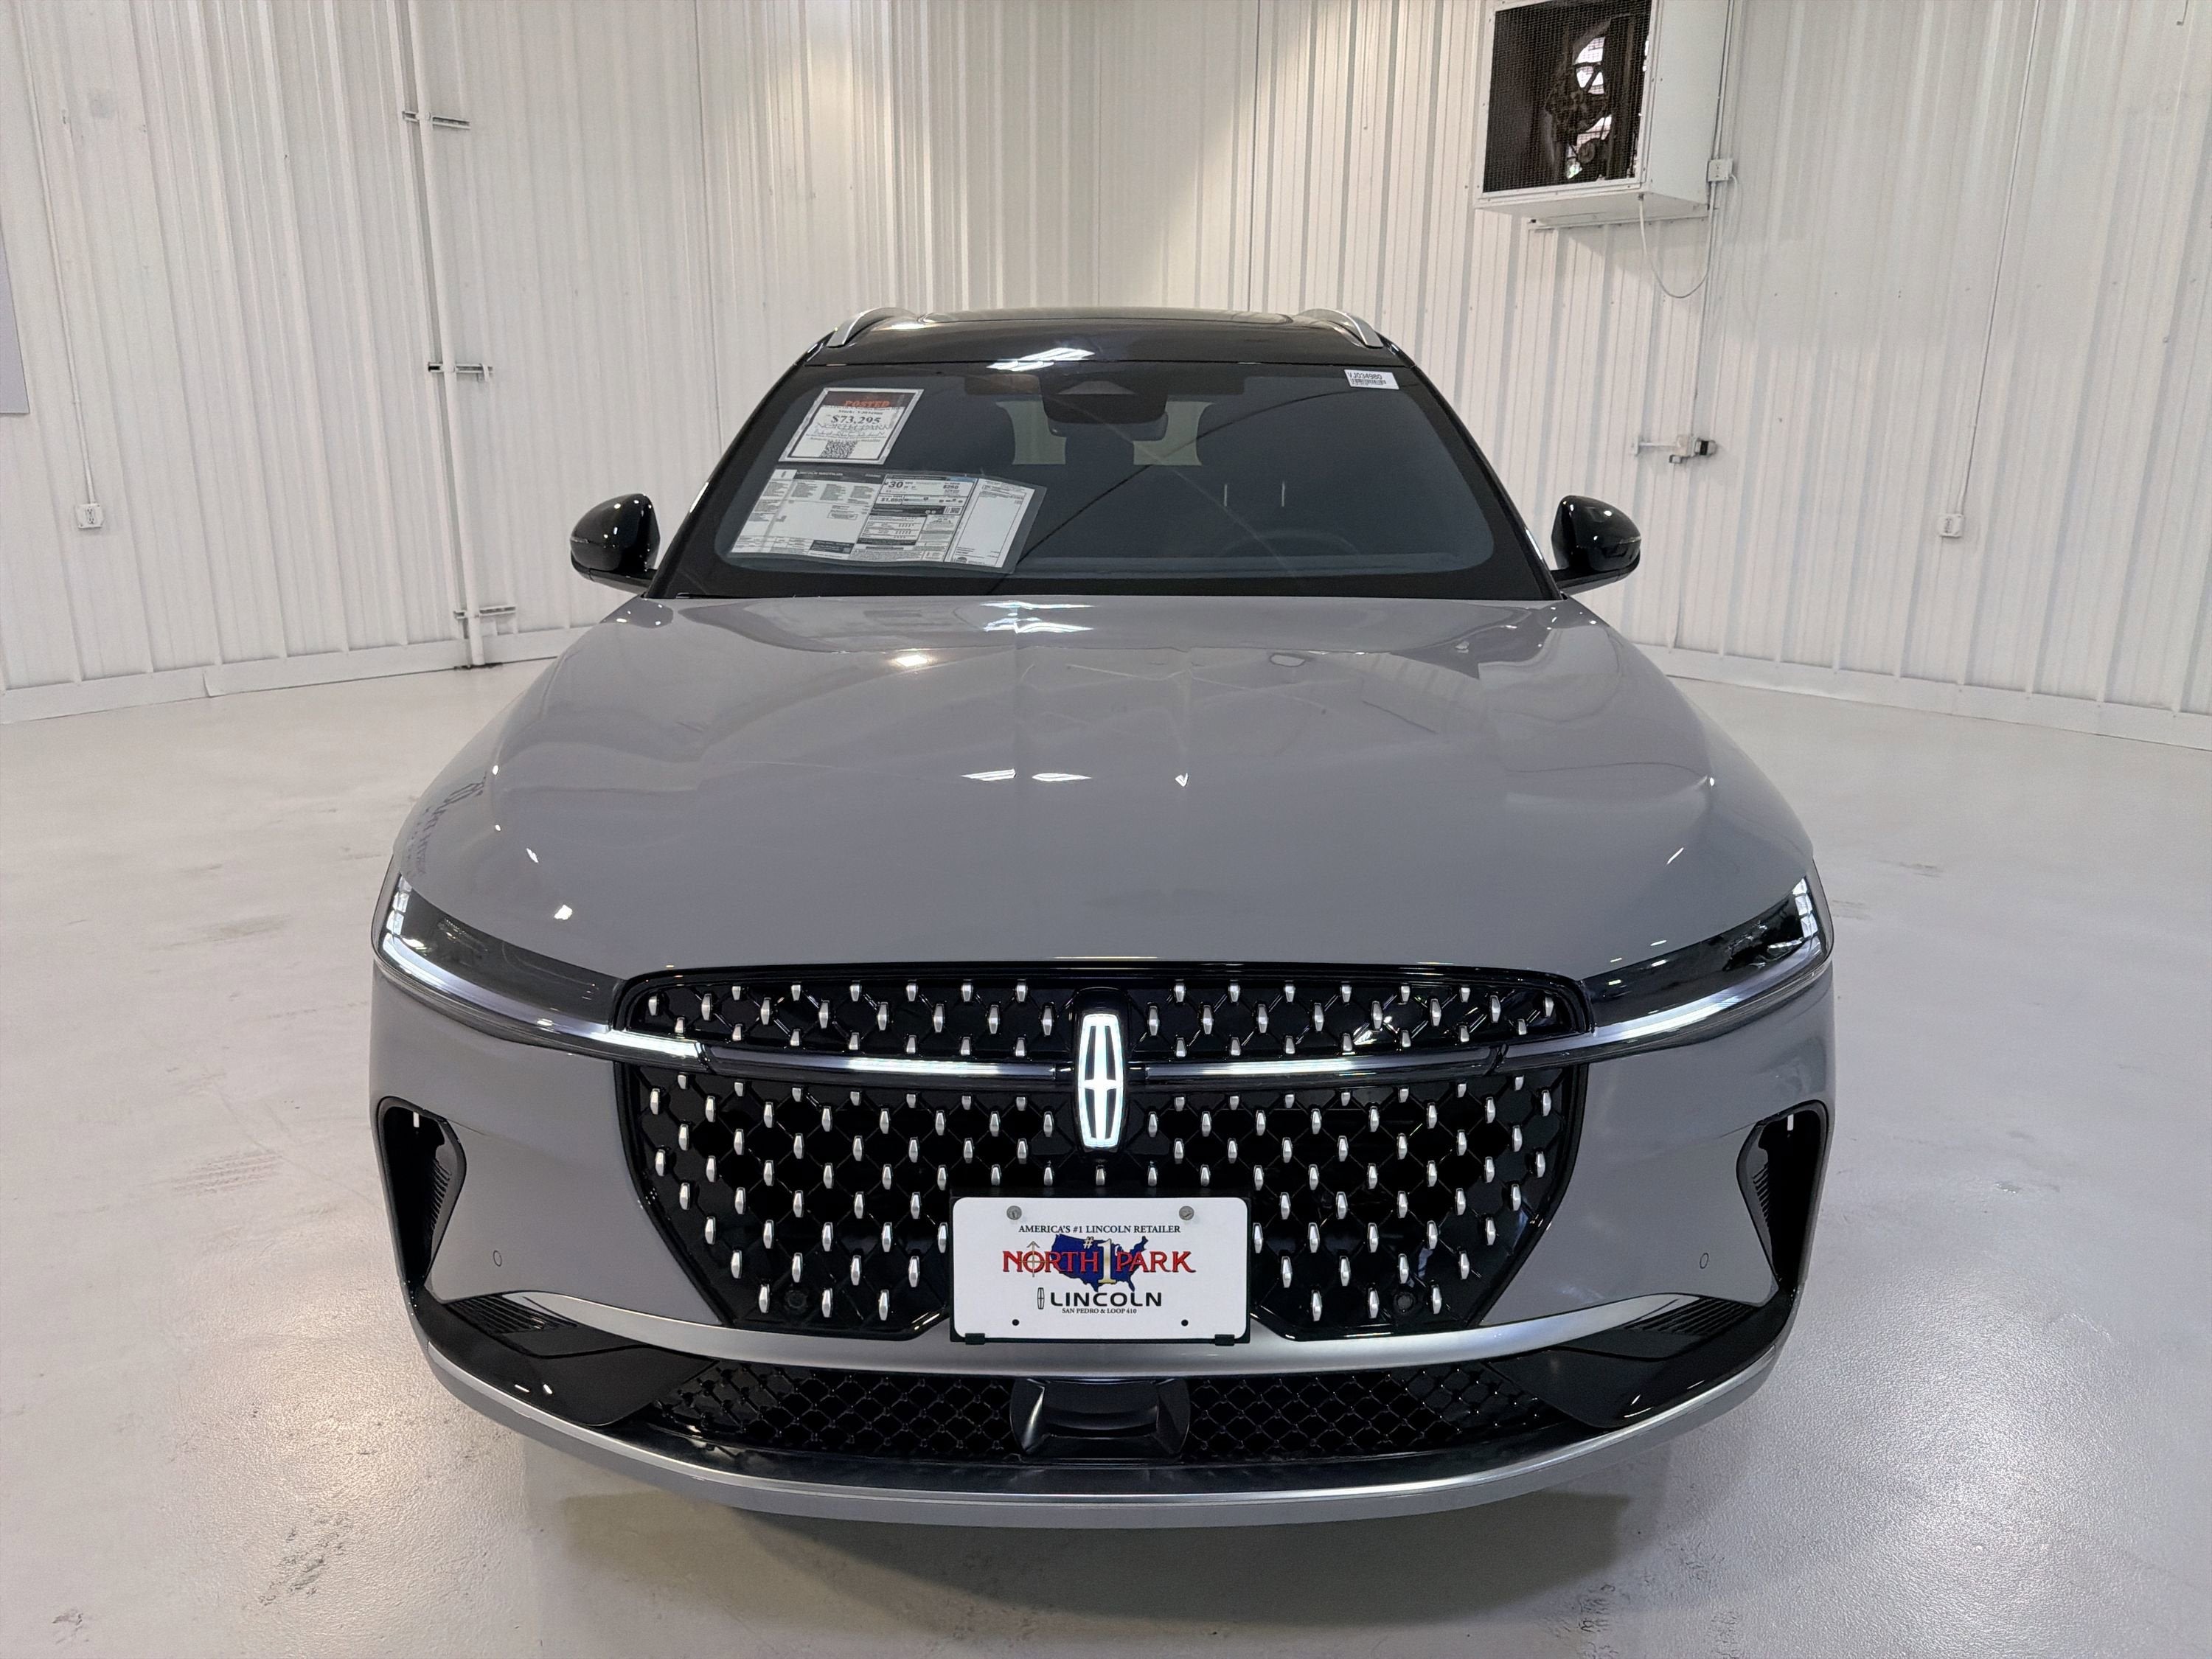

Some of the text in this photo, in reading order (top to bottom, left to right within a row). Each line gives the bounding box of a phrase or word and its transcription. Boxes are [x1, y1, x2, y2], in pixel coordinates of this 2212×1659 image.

[888, 481, 903, 489] 30
[1018, 1225, 1181, 1234] AMERICA'S #1 LINCOLN RETAILER
[1002, 1251, 1197, 1273] NORTH PARK
[1050, 1292, 1162, 1307] LINCOLN
